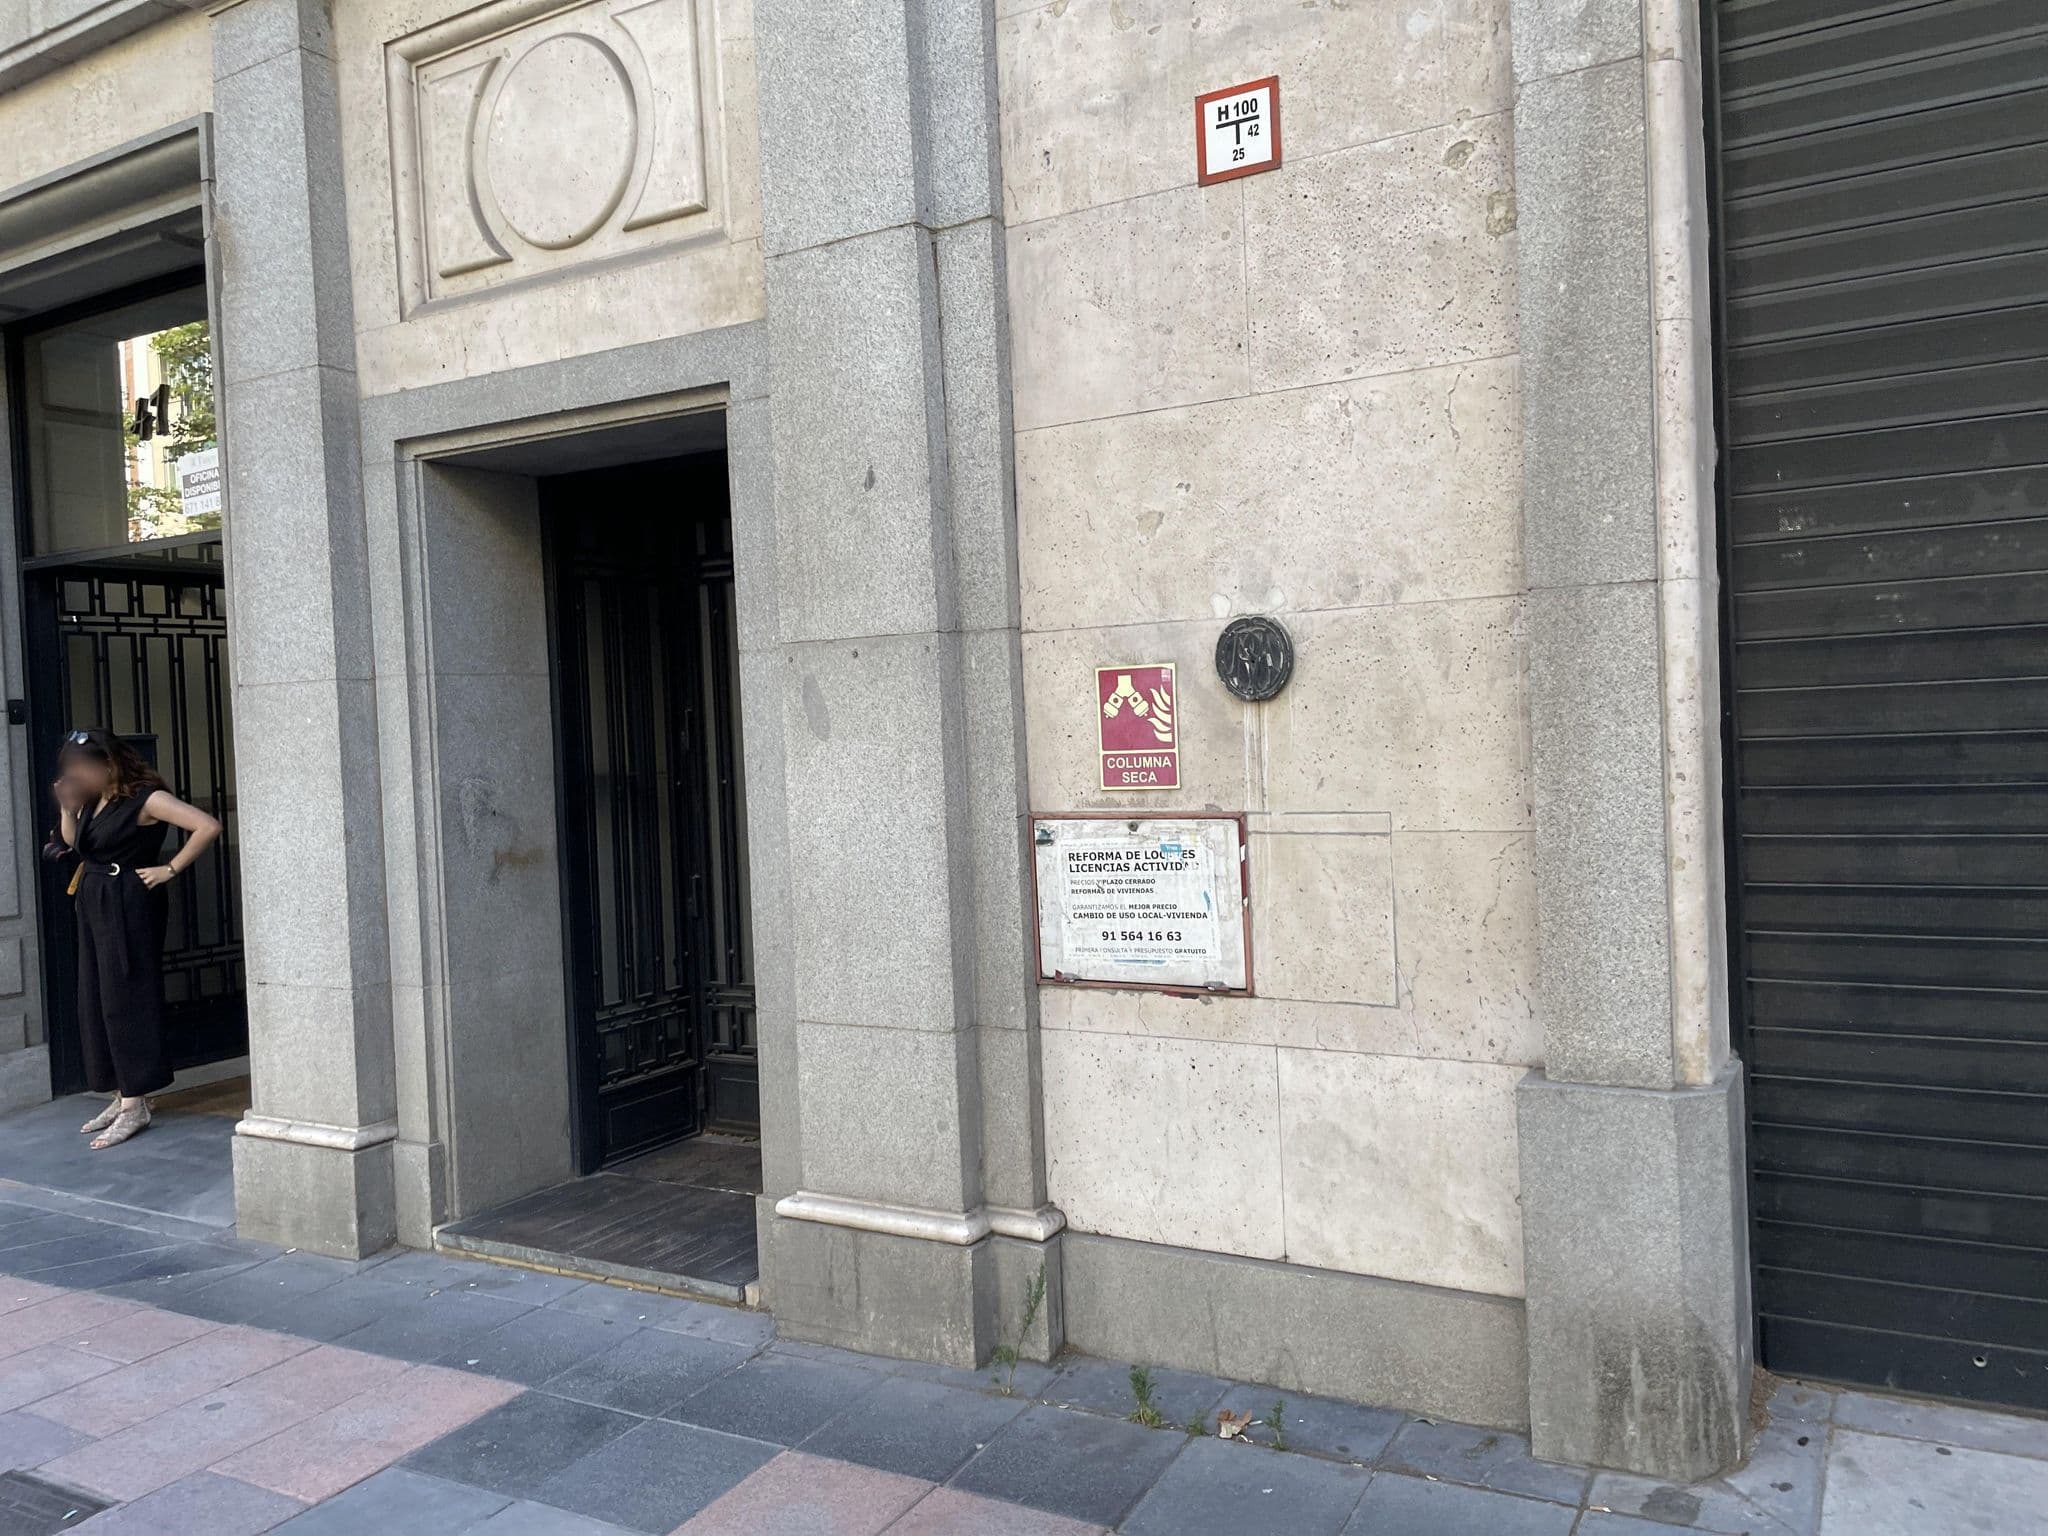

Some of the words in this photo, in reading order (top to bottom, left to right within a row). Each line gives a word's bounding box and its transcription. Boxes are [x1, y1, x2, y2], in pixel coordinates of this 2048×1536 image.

[1217, 104, 1229, 122] H
[1233, 98, 1258, 117] 100
[1247, 124, 1260, 137] 42
[1232, 147, 1245, 162] 25
[190, 468, 220, 484] OFICINA
[1106, 756, 1172, 769] COLUMNA
[1122, 771, 1158, 783] SECA
[1068, 851, 1122, 862] REFORMA
[1126, 850, 1141, 860] DE
[1144, 849, 1196, 860] LOCES
[1069, 863, 1130, 873] LICENCIAS
[1138, 911, 1208, 919] LOCAL-VIVIENDA
[1101, 931, 1117, 941] 91
[1120, 931, 1143, 941] 564
[1148, 931, 1163, 941] 16
[1166, 931, 1182, 942] 63
